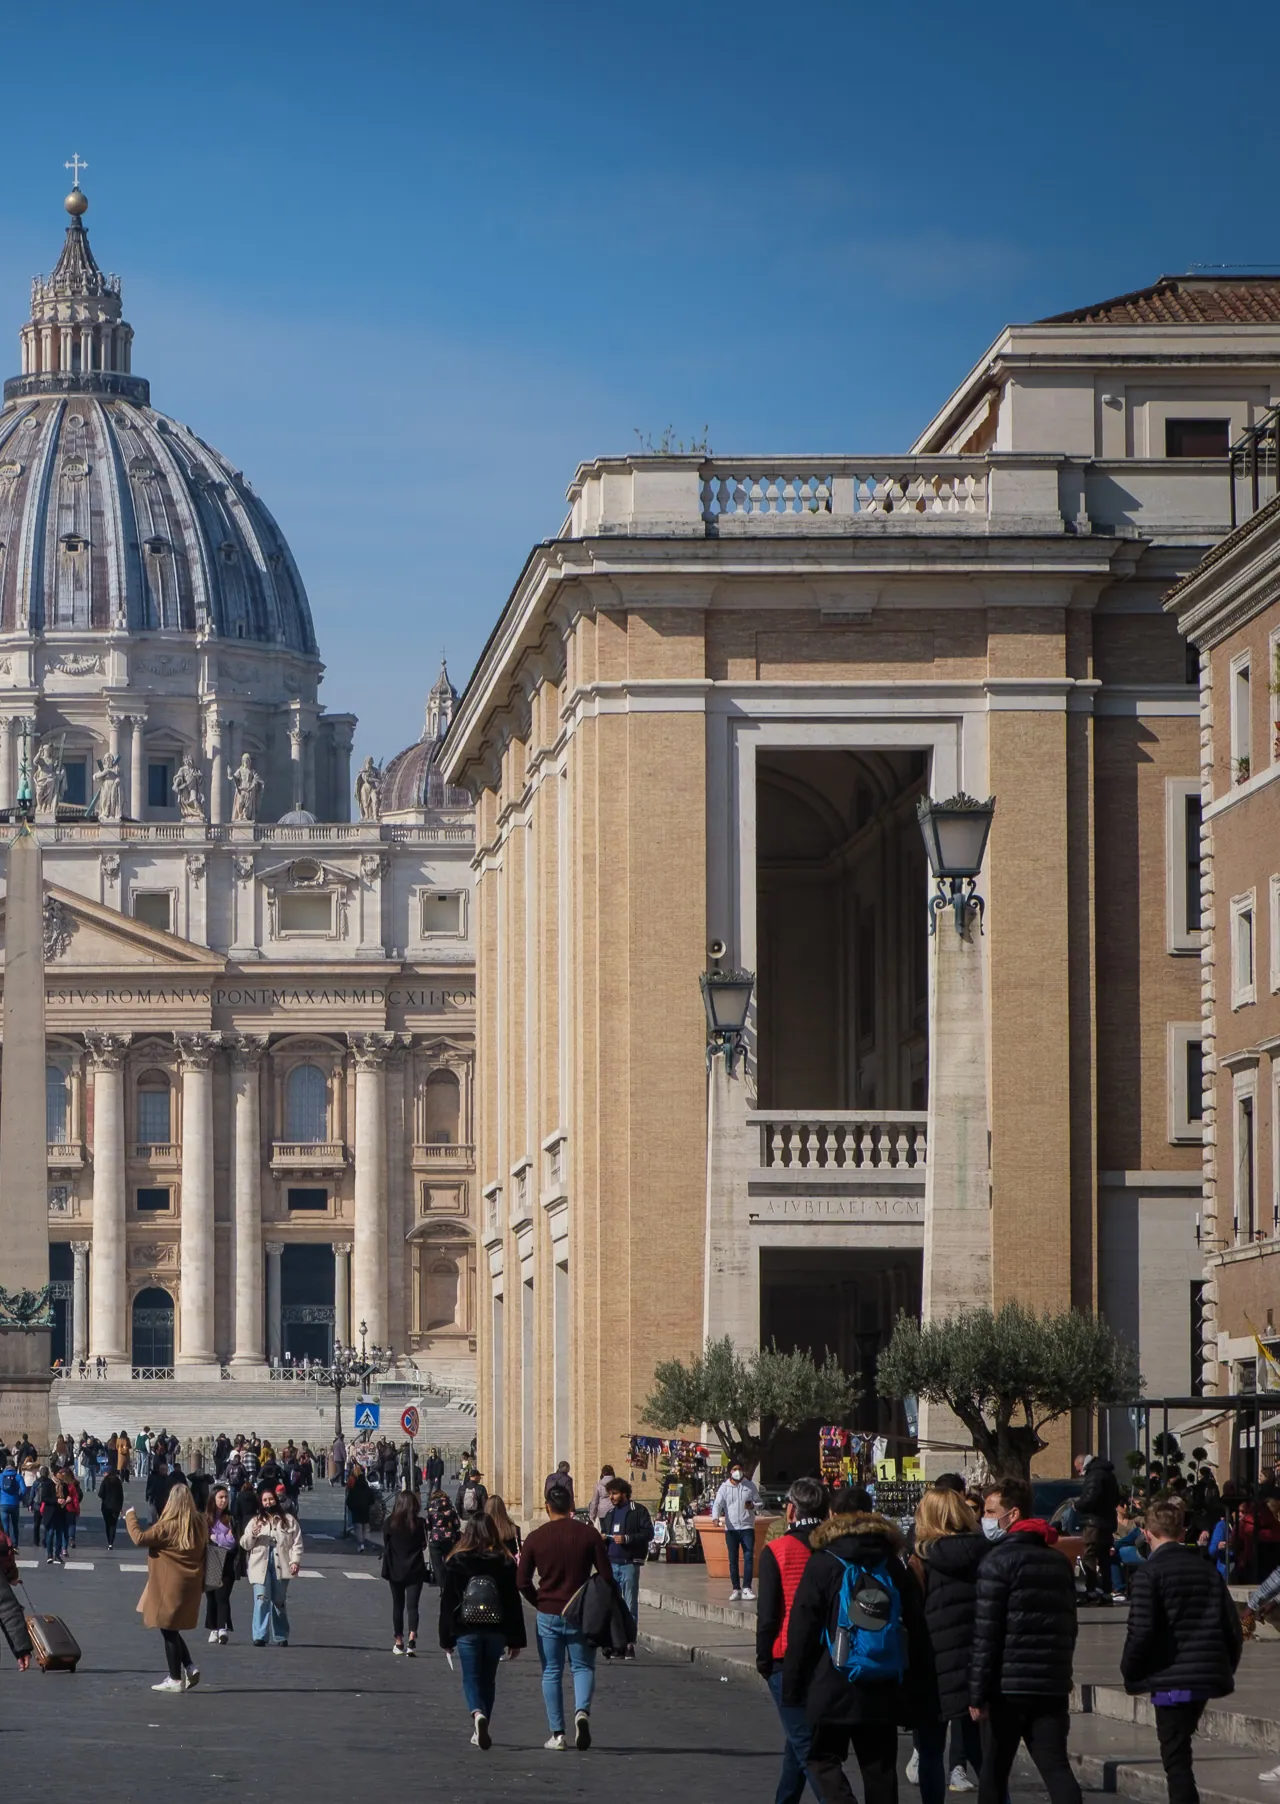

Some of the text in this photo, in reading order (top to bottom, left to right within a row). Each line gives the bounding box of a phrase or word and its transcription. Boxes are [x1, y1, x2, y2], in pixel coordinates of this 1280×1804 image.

[105, 989, 210, 1004] ROMANVS
[216, 989, 270, 1005] PONT
[271, 989, 316, 1005] MAX
[319, 989, 348, 1005] AN
[783, 1201, 865, 1215] IVBILAEI
